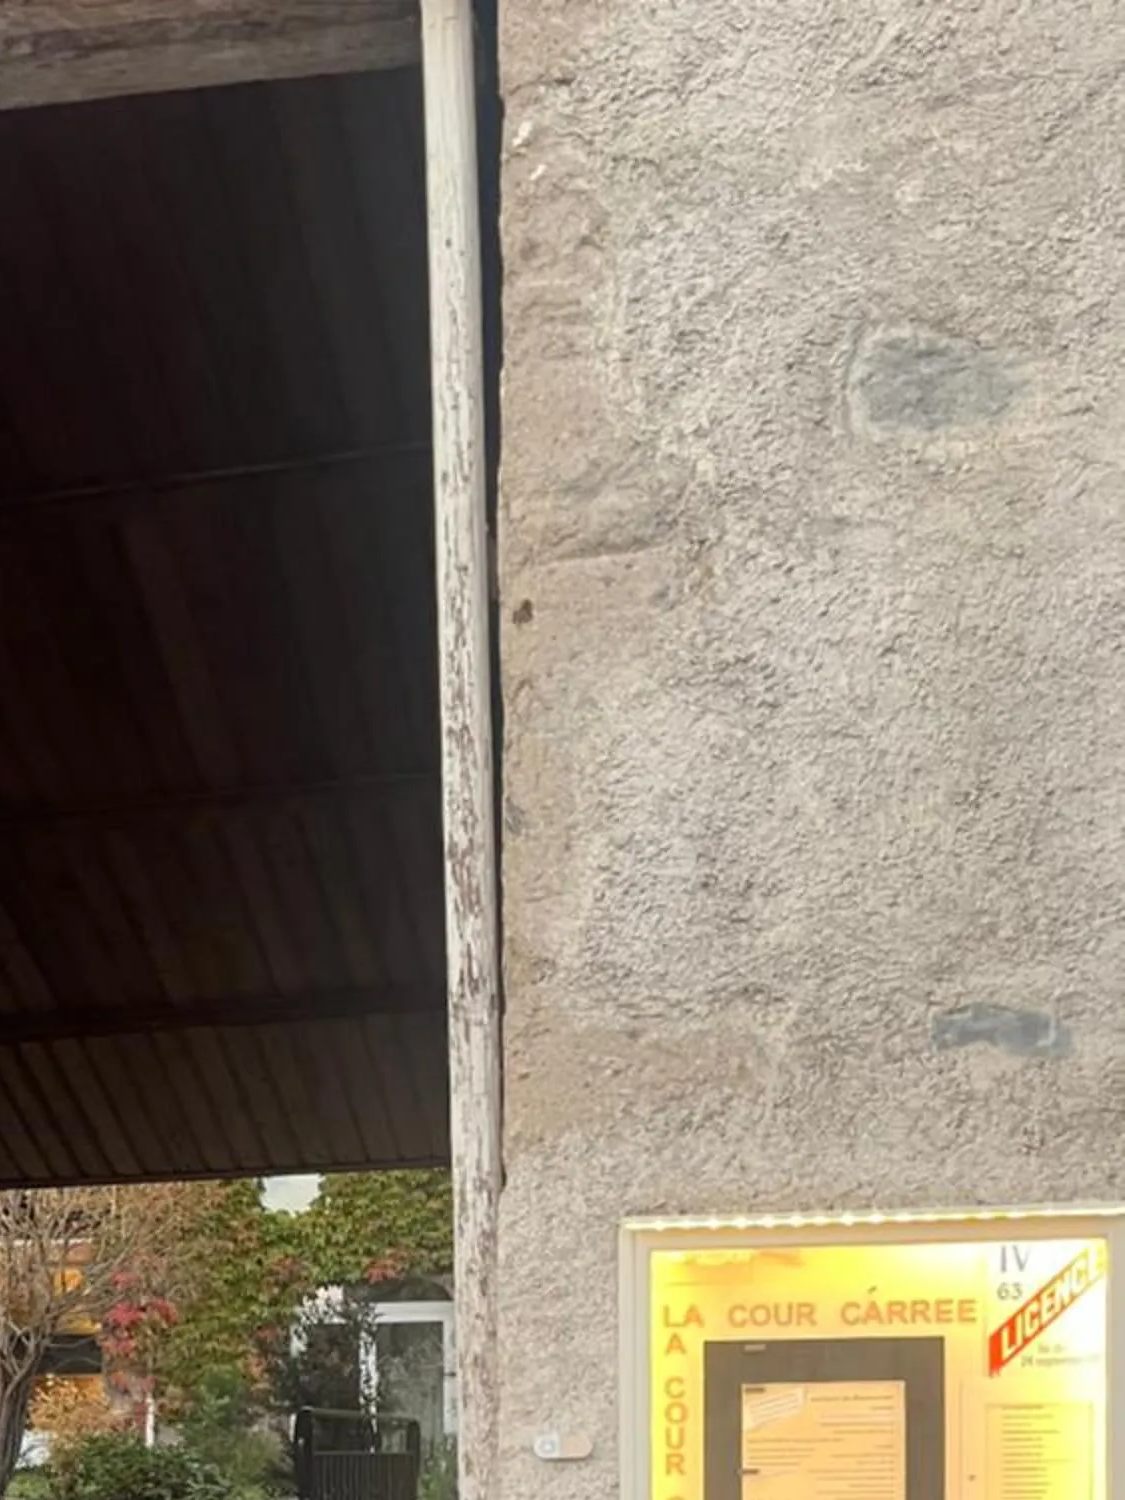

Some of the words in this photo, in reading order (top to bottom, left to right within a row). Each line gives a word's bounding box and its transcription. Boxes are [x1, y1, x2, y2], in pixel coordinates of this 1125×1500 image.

[999, 1244, 1032, 1274] IV
[996, 1281, 1024, 1301] 63
[663, 1303, 705, 1329] LA
[727, 1302, 817, 1327] COUR
[663, 1375, 688, 1477] COUR
